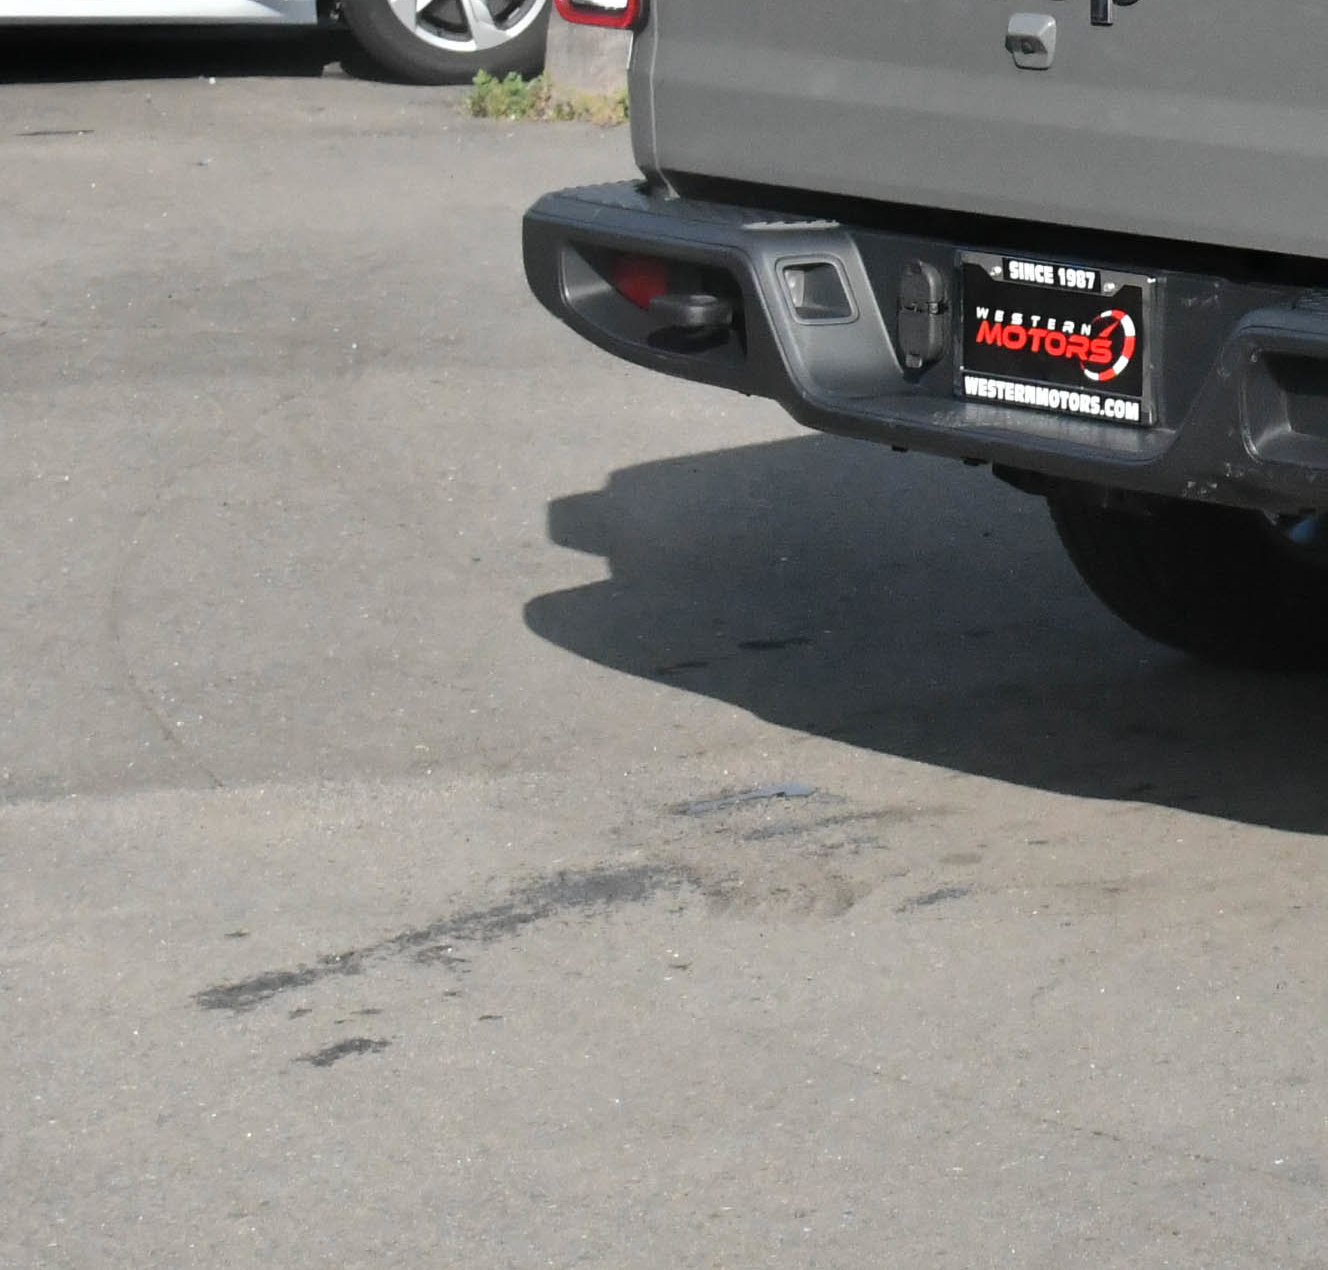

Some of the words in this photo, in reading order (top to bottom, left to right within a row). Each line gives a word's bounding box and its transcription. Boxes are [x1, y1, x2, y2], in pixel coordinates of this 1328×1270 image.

[1009, 260, 1054, 284] SINCE
[1058, 267, 1096, 290] 1987
[976, 306, 1092, 336] WESTERN
[975, 319, 1113, 364] MOTORS
[964, 376, 1140, 421] WESTERNMOTORS.COM
